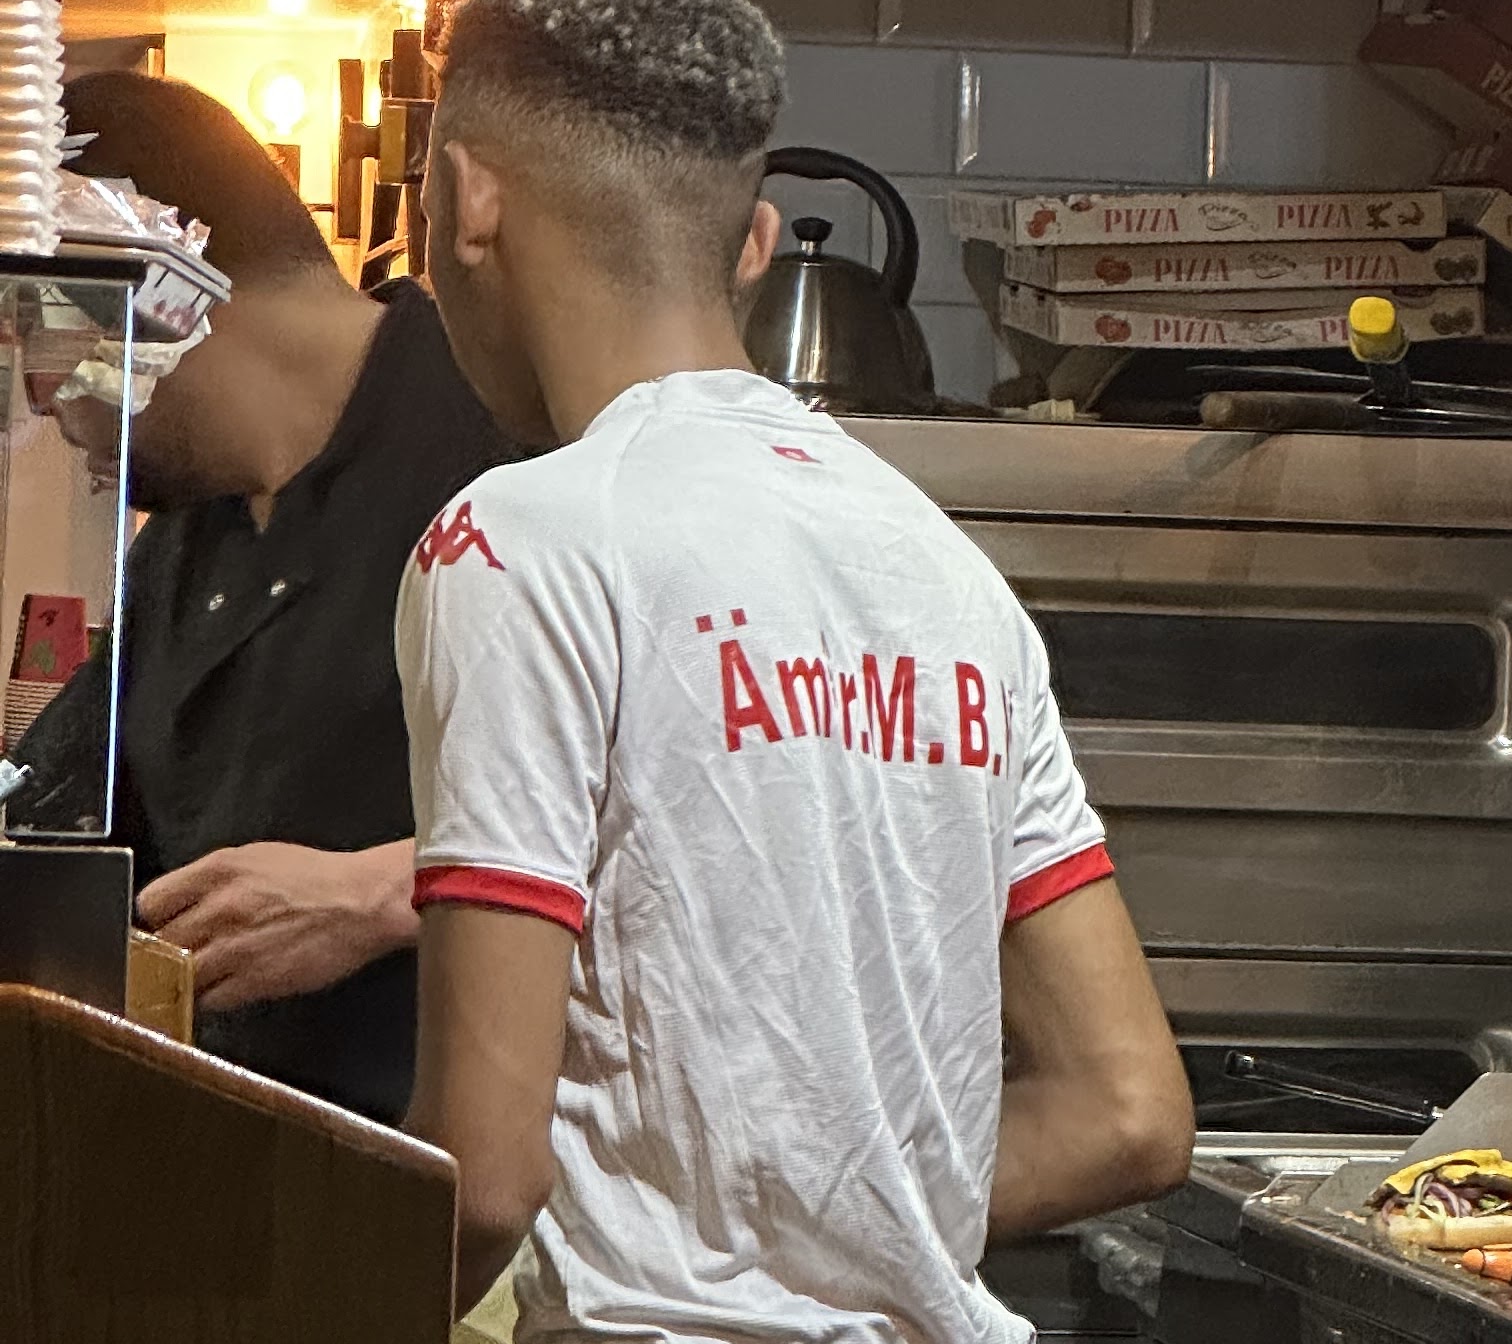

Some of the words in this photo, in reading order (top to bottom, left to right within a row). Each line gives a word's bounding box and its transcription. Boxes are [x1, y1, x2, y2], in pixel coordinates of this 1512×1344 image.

[1104, 208, 1179, 233] PIZZA
[1277, 204, 1352, 229] PIZZA
[1154, 258, 1230, 283] PIZZA
[1324, 256, 1400, 281] PIZZA
[1153, 319, 1228, 344] PIZZA
